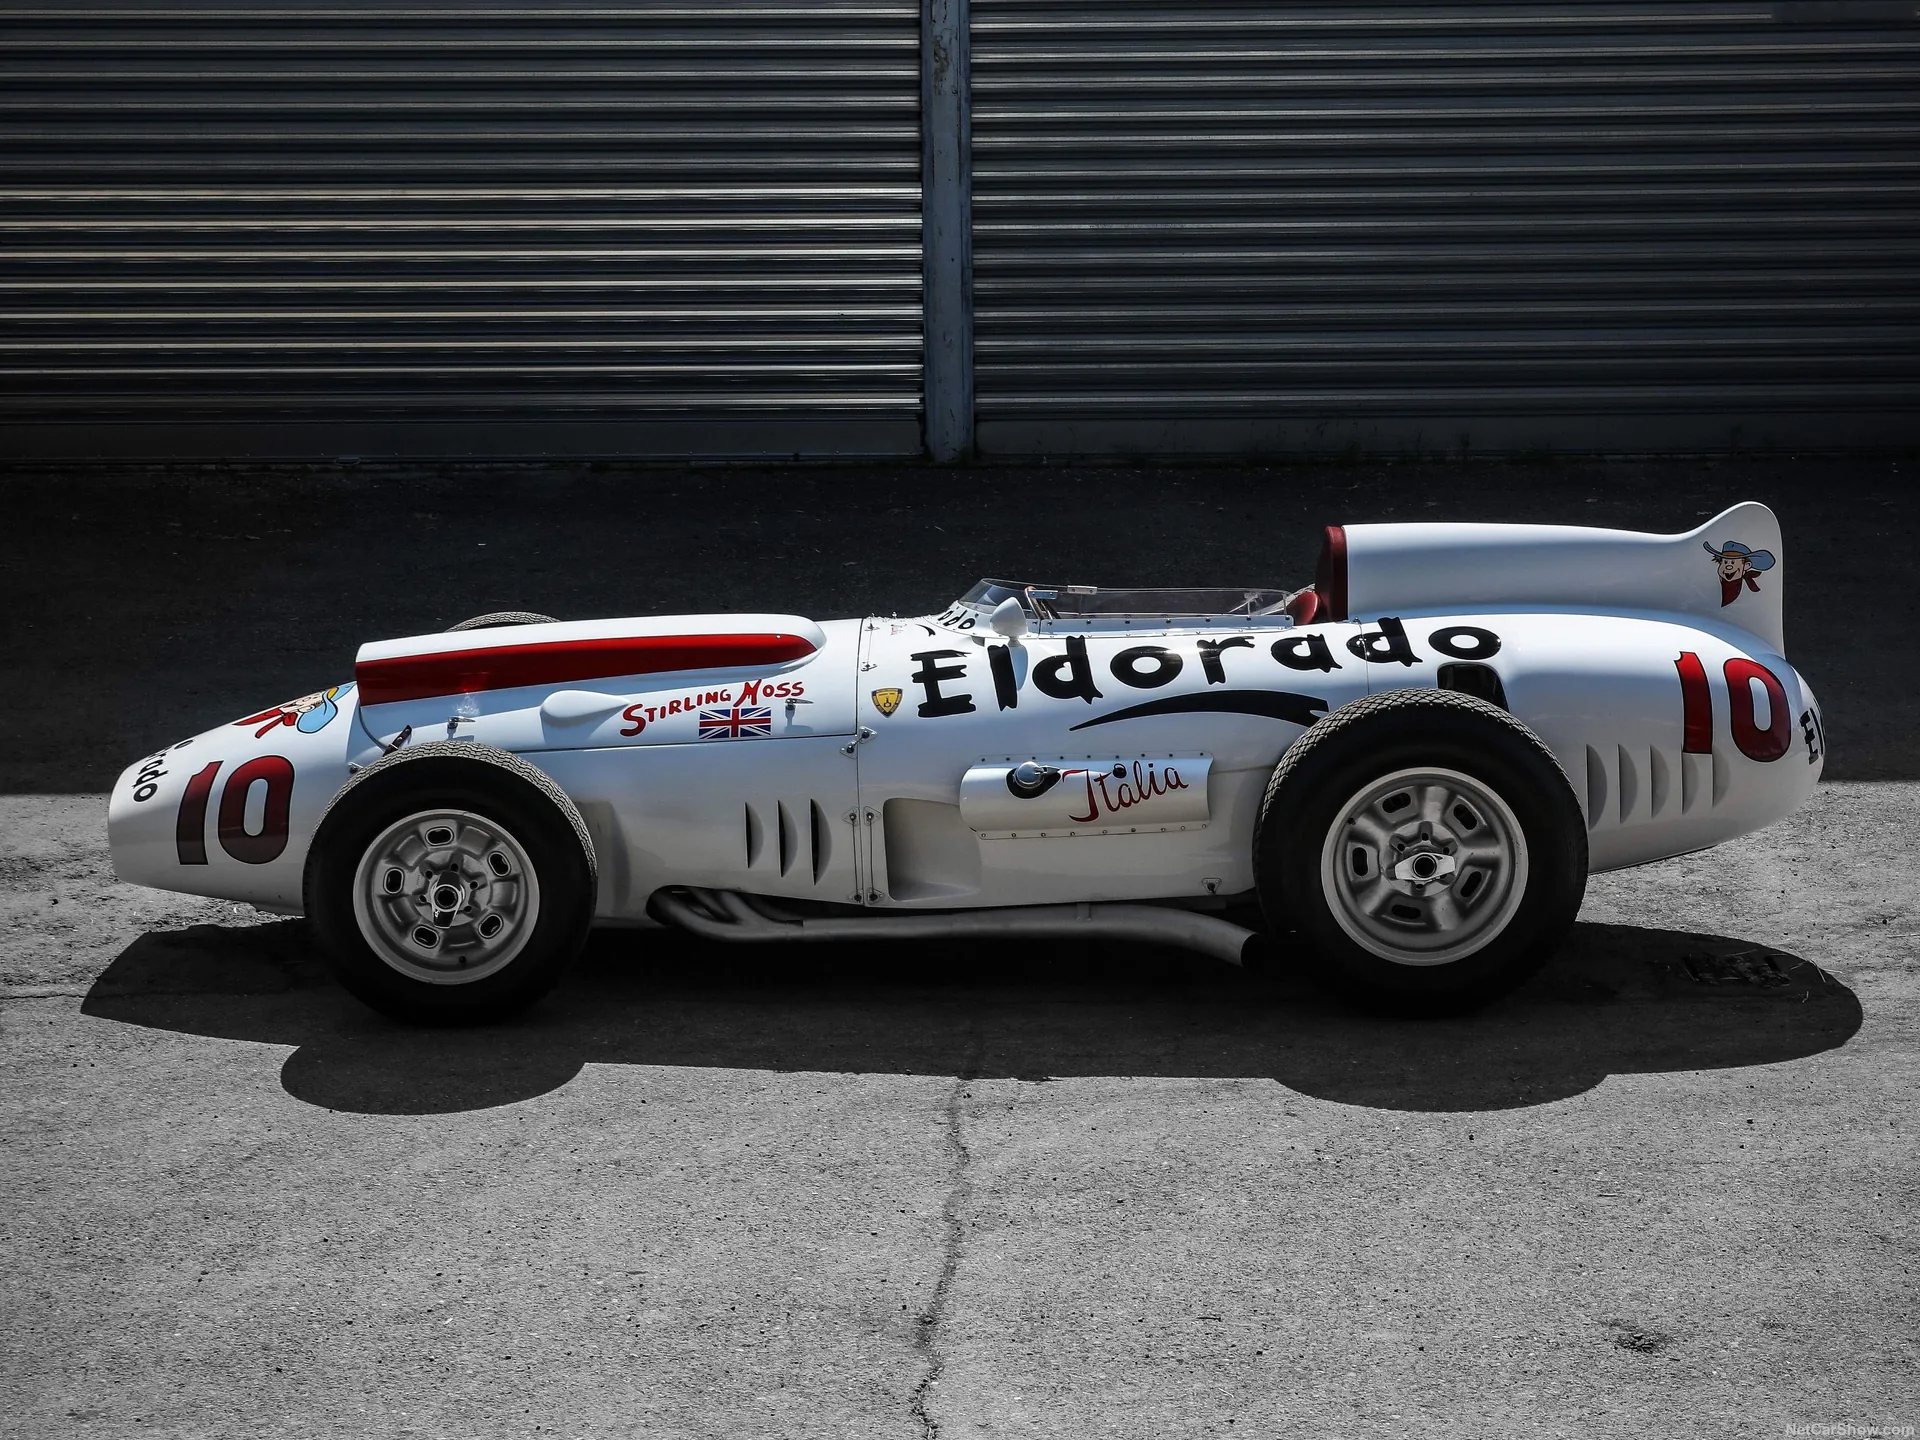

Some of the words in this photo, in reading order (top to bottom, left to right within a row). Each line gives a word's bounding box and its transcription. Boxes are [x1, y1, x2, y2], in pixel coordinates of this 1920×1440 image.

[620, 688, 731, 737] STIRLING
[732, 678, 805, 707] MOSS
[911, 617, 1501, 718] Eldorado
[1674, 651, 1792, 763] 10
[176, 754, 295, 866] 10
[1062, 760, 1189, 823] Italia
